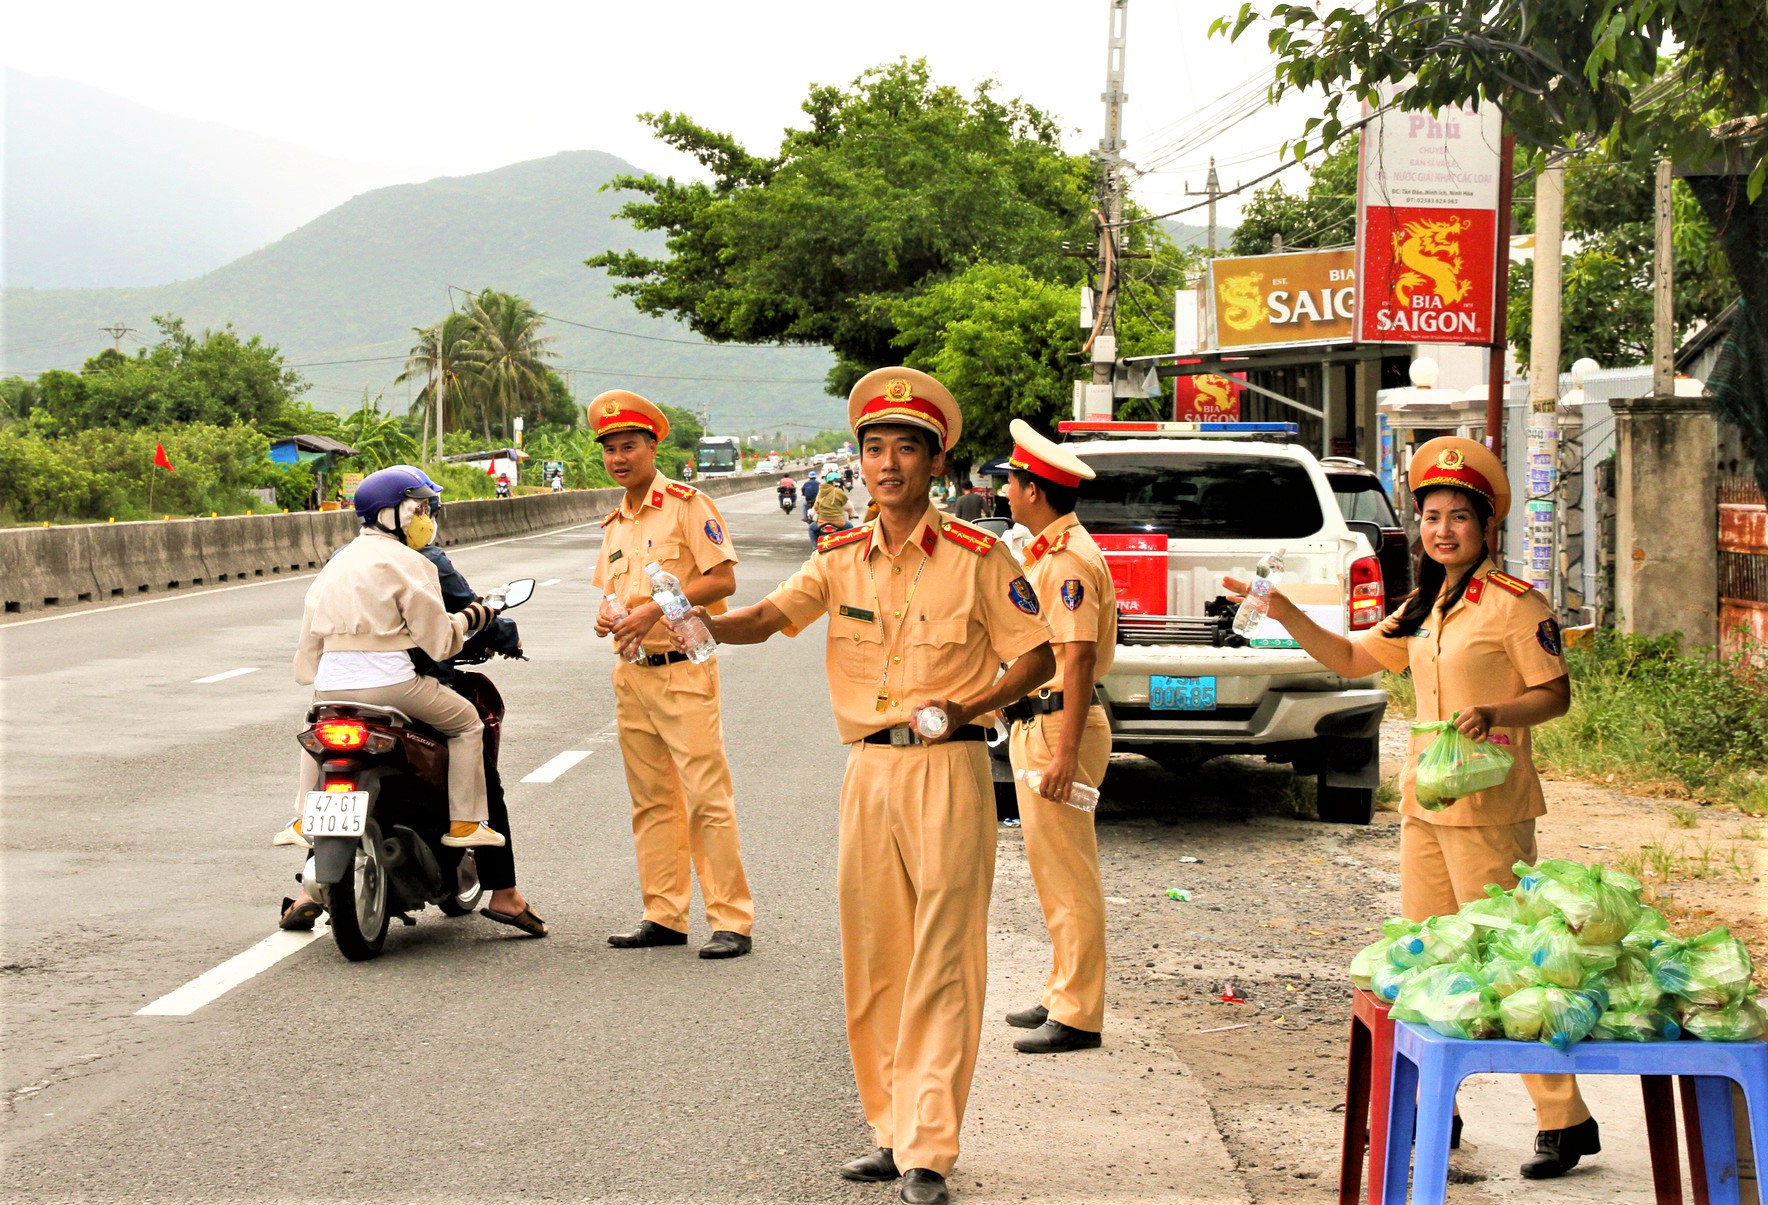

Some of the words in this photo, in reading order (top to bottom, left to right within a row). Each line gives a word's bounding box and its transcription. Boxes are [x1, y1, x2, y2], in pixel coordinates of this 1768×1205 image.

[1408, 115, 1461, 138] Phú
[1329, 269, 1355, 281] BIA
[1272, 278, 1288, 286] EST.
[1412, 295, 1443, 309] BIA
[1376, 308, 1476, 333] SAIGON
[1203, 405, 1221, 413] BIA
[1184, 413, 1240, 423] SAIGON
